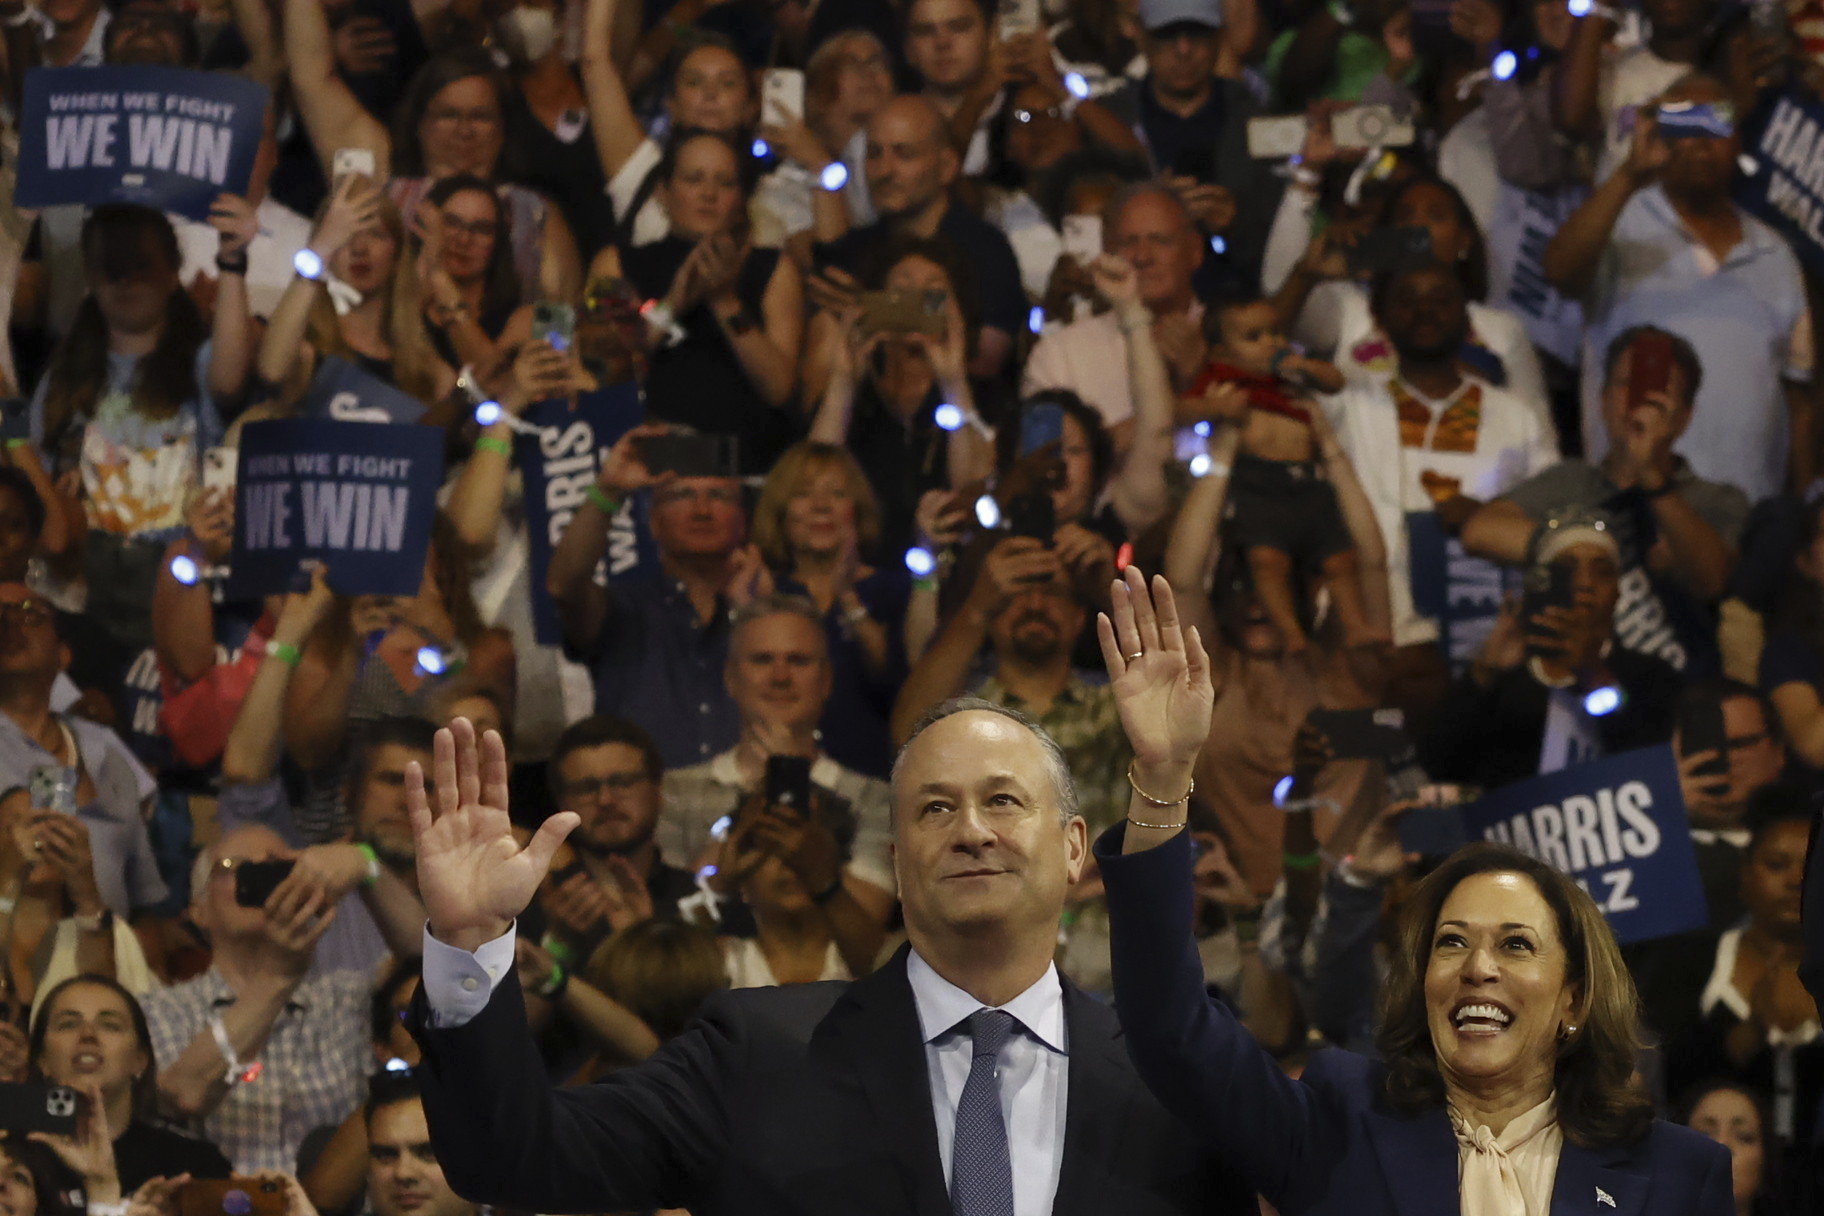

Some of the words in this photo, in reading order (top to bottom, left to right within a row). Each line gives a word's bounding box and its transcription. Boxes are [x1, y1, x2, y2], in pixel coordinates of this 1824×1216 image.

[49, 91, 120, 112] WHEN
[122, 92, 160, 111] WE
[165, 94, 235, 122] FIGHT
[46, 113, 119, 170] WE
[128, 113, 233, 185] WIN
[293, 452, 332, 477] WE
[337, 453, 413, 481] FIGHT
[244, 480, 294, 552] WE
[299, 480, 410, 553] WIN
[1482, 780, 1661, 874] ARRIS
